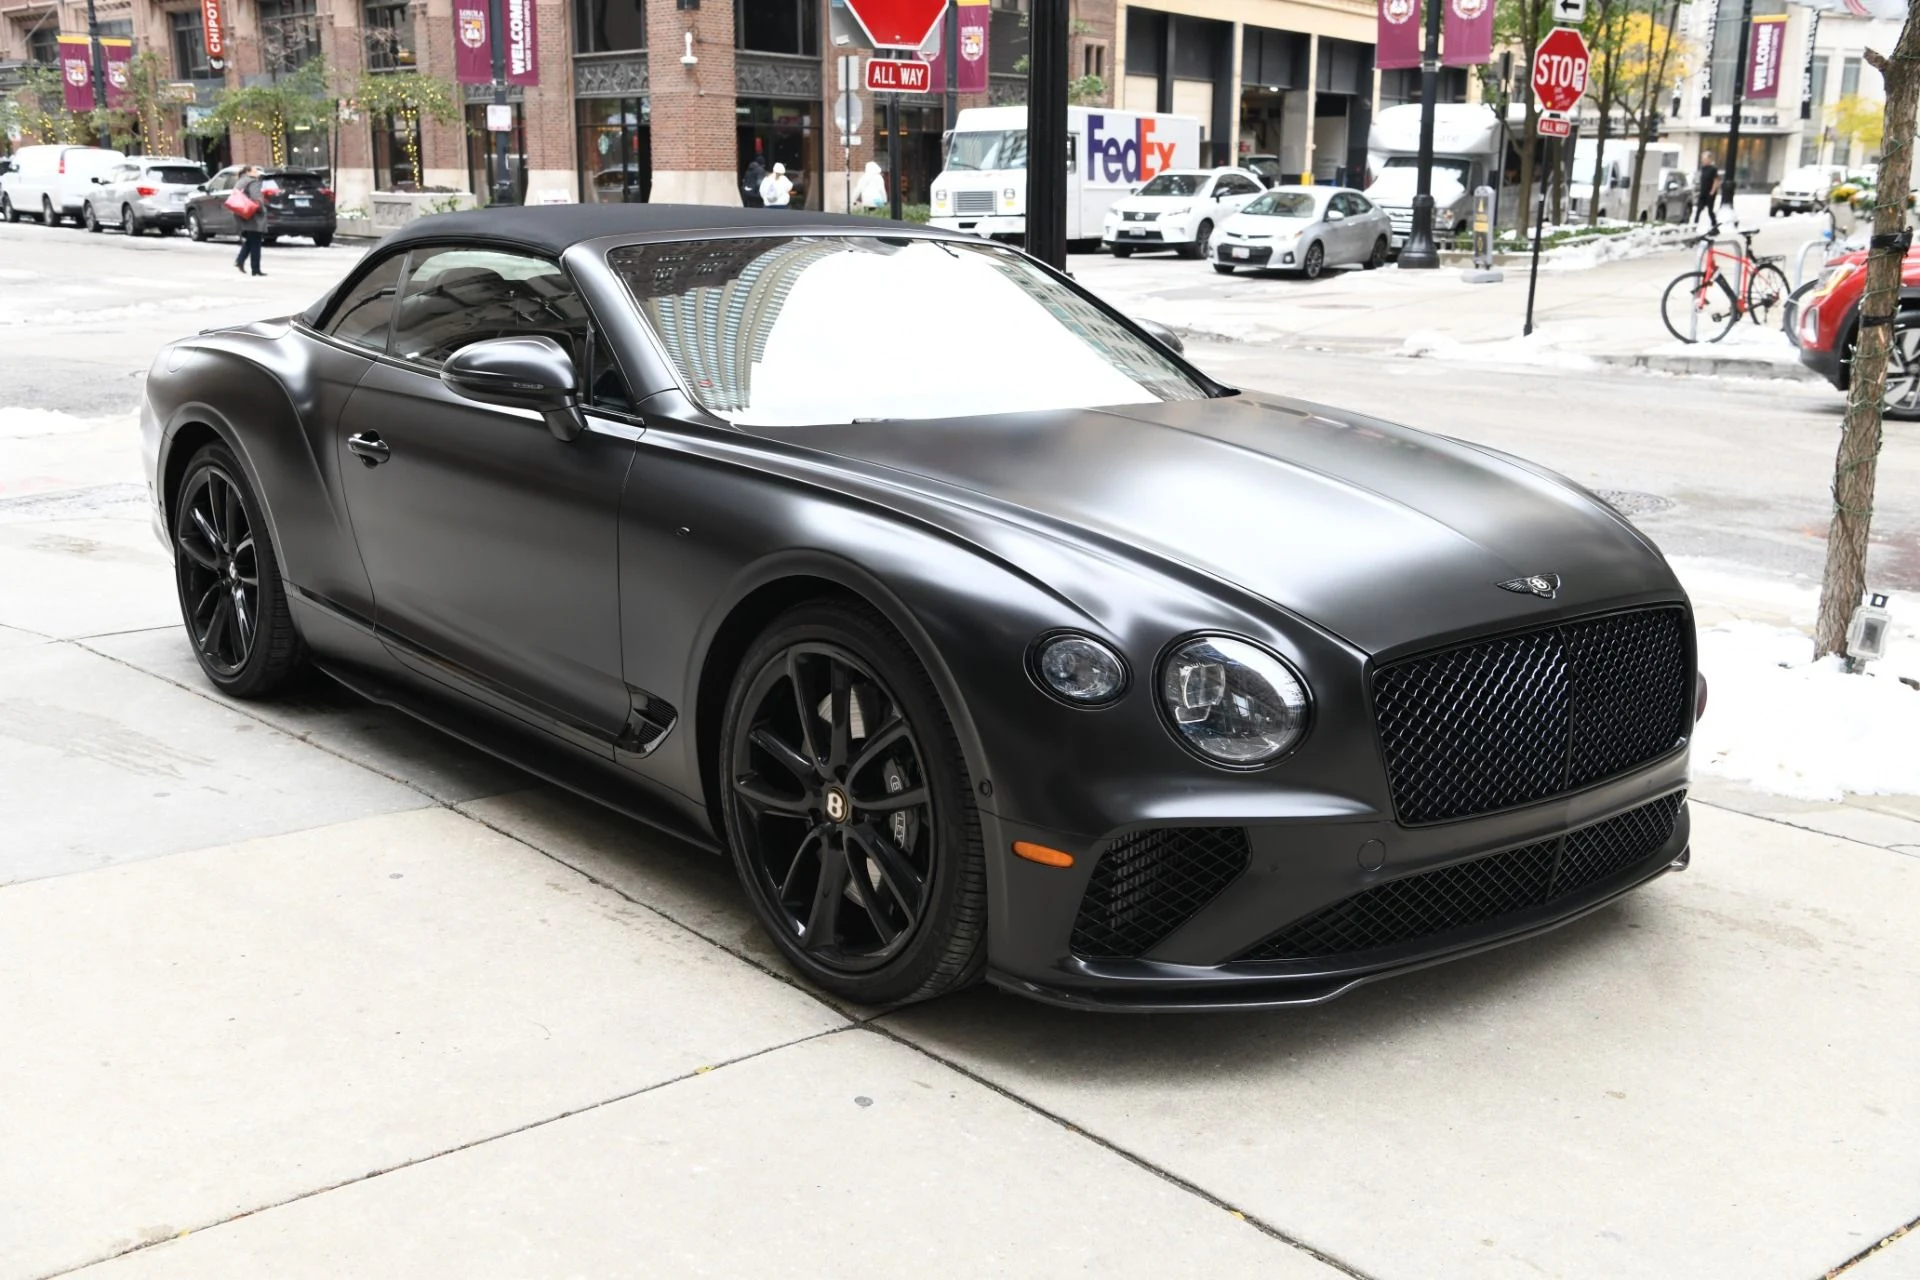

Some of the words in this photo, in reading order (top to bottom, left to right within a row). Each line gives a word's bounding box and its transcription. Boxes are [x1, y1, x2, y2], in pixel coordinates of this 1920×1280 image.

[1536, 53, 1586, 88] STOP
[1752, 24, 1773, 91] WELCOME
[873, 66, 896, 84] ALL
[900, 67, 924, 86] WAY
[1087, 114, 1176, 184] FedEx
[827, 792, 843, 818] B
